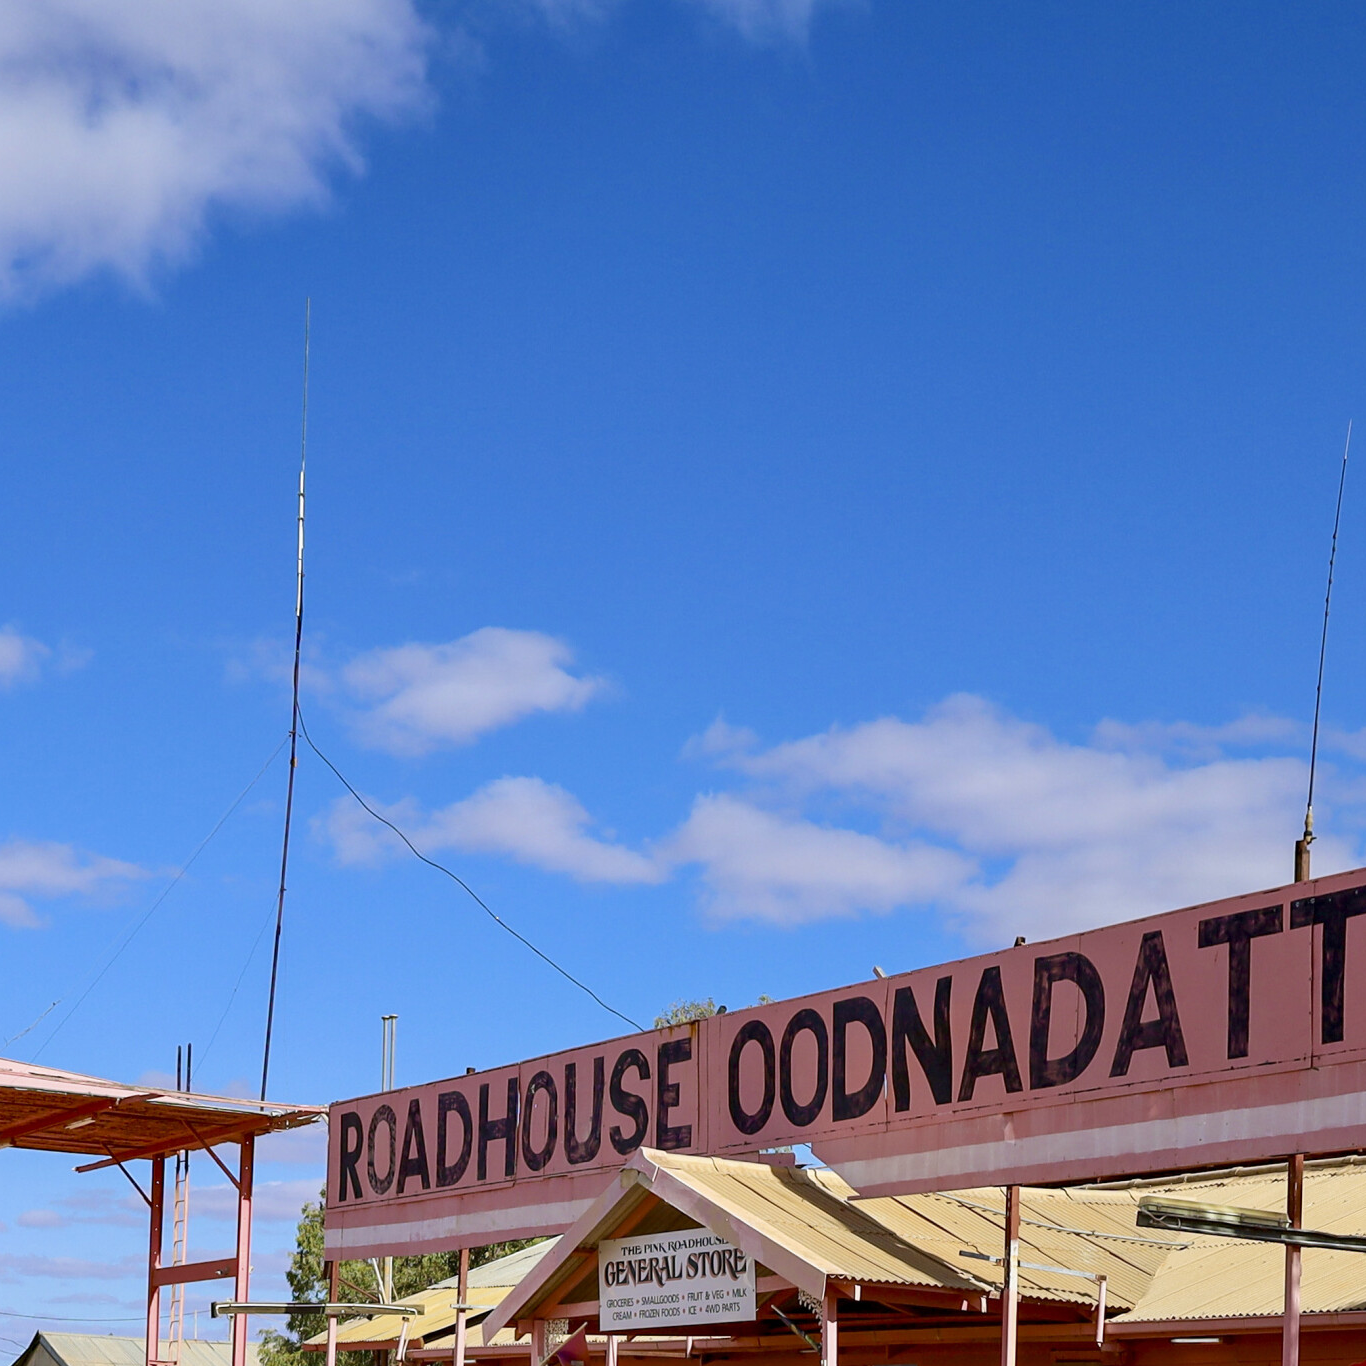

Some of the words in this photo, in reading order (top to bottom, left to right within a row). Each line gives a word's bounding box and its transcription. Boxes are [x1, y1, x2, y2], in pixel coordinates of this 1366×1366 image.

[338, 1037, 693, 1203] ROADHOUSE
[621, 1245, 642, 1257] THE
[644, 1242, 668, 1254] PINK
[604, 1254, 683, 1289] GENERAL
[686, 1247, 747, 1282] STORE
[606, 1297, 634, 1308] GROCERIES
[641, 1293, 680, 1306] SMALLGOODS
[687, 1291, 703, 1302] FRUIT
[705, 1291, 710, 1300] &
[711, 1289, 724, 1300] VEG
[732, 1287, 747, 1298] MILK
[612, 1310, 633, 1321] CREAM
[639, 1308, 660, 1319] FROZEN
[661, 1306, 681, 1317] FOODS
[688, 1305, 697, 1315] ICE
[705, 1303, 721, 1314] 4WD
[722, 1302, 741, 1312] PARTS
